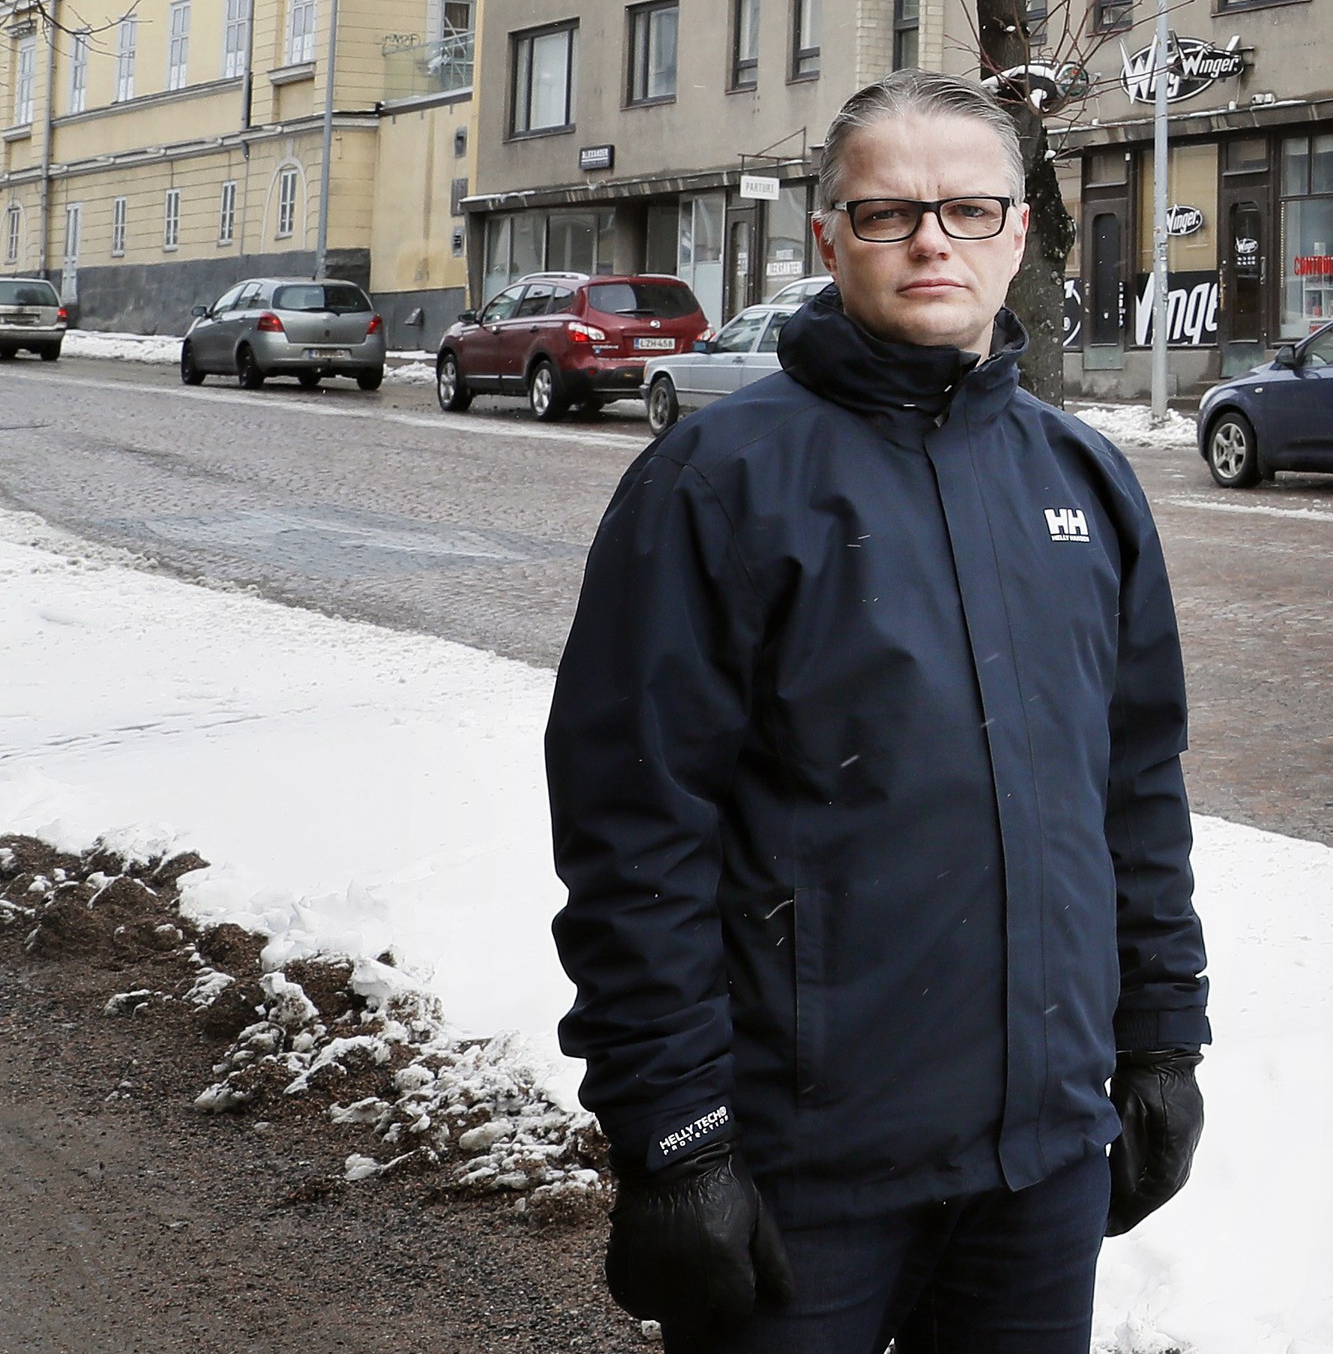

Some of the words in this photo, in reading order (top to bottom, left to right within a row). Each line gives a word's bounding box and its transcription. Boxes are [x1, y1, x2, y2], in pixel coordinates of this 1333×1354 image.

[1294, 255, 1333, 275] CONTROL
[1044, 509, 1088, 535] HH
[659, 1124, 694, 1150] HELLY
